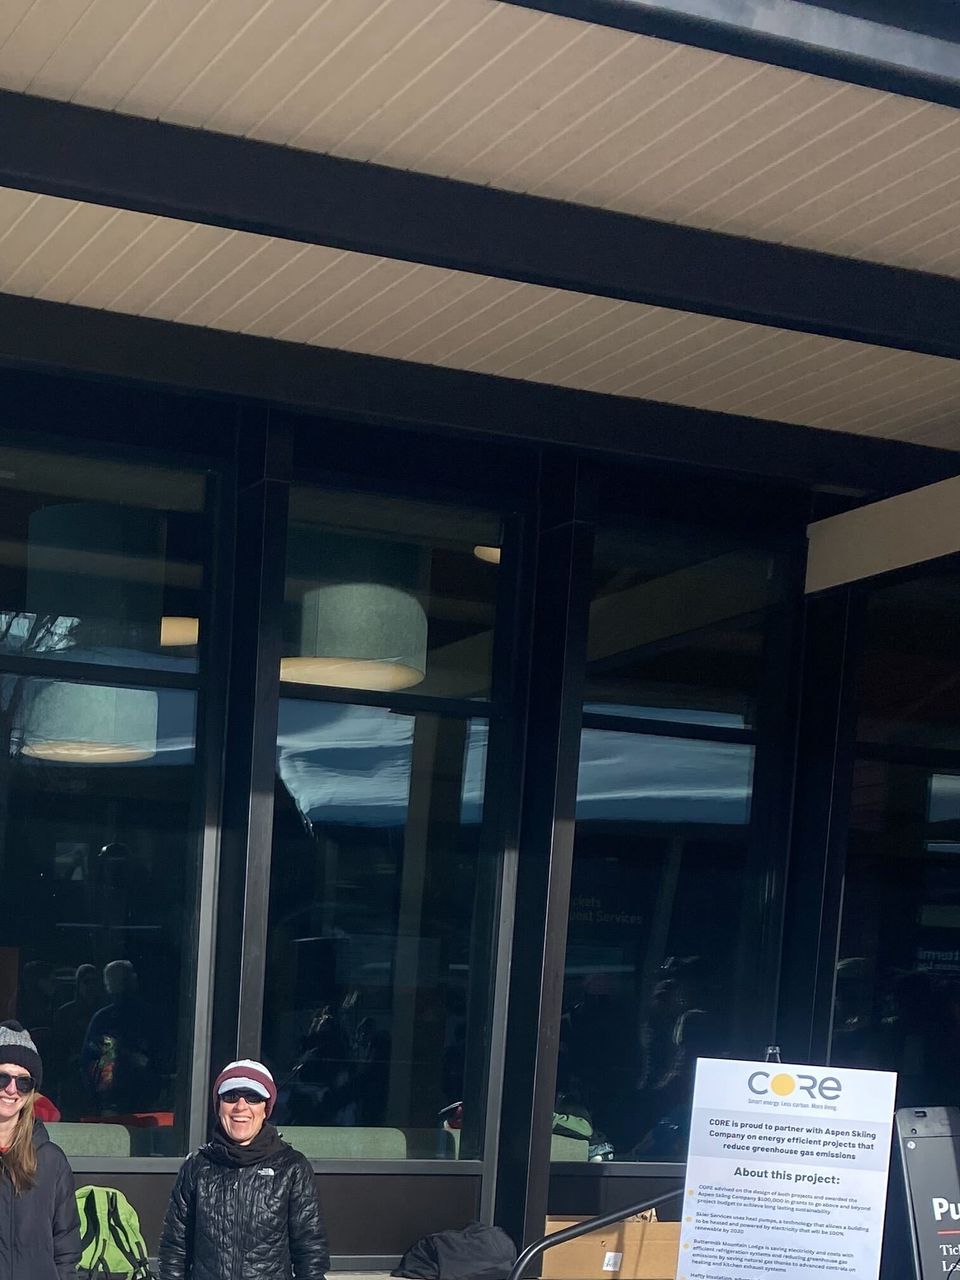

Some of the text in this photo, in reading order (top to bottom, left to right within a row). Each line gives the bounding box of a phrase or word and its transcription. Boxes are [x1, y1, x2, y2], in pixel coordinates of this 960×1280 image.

[709, 1119, 730, 1127] CORE
[805, 1127, 823, 1135] with
[825, 1128, 850, 1137] Aspen
[852, 1130, 876, 1140] Skiing
[709, 1130, 745, 1141] Company
[758, 1136, 785, 1144] energy
[787, 1137, 821, 1146] efficient
[823, 1141, 856, 1149] projects
[723, 1143, 750, 1151] reduce
[752, 1146, 798, 1155] greenhouse
[816, 1151, 856, 1160] emissions
[734, 1167, 840, 1185] About this project:
